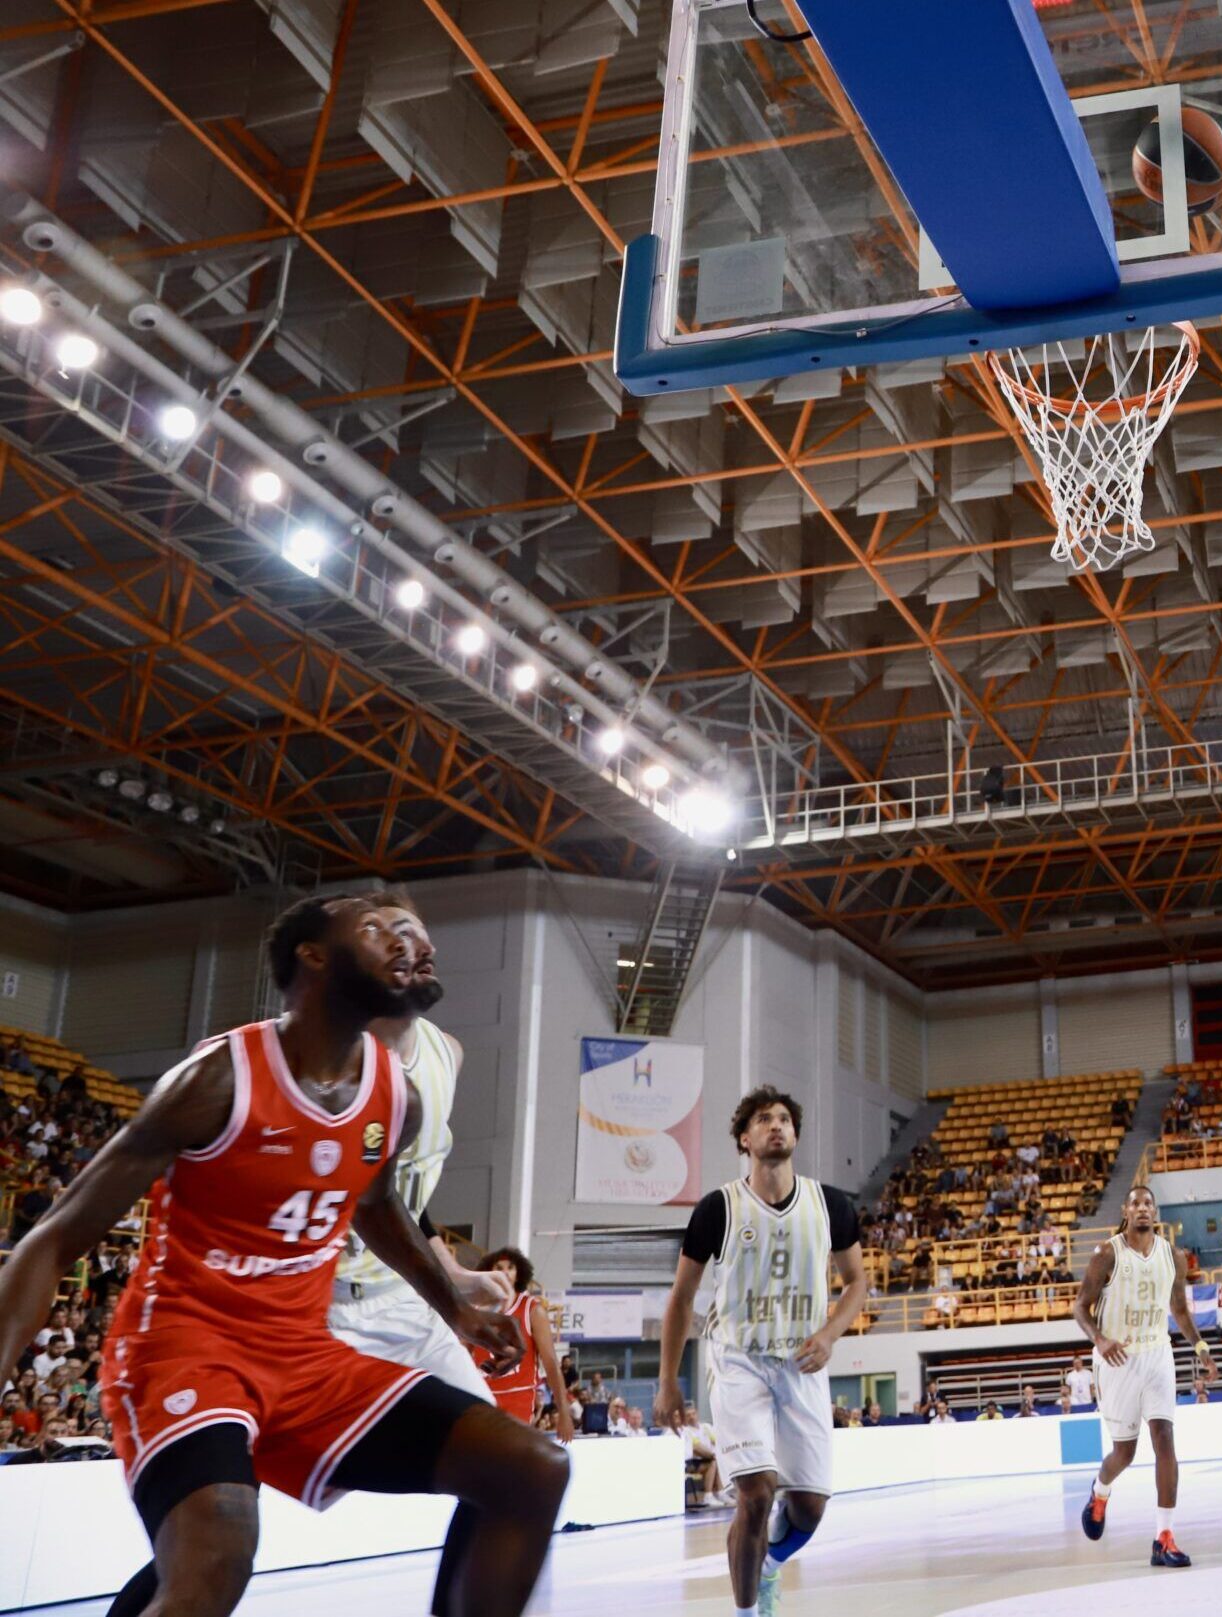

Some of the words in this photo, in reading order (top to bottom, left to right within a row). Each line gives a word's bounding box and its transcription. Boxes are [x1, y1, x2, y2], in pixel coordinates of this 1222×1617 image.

[267, 1190, 349, 1243] 45
[770, 1249, 791, 1280] 9
[745, 1286, 813, 1324] tarfin
[1137, 1281, 1156, 1301] 21
